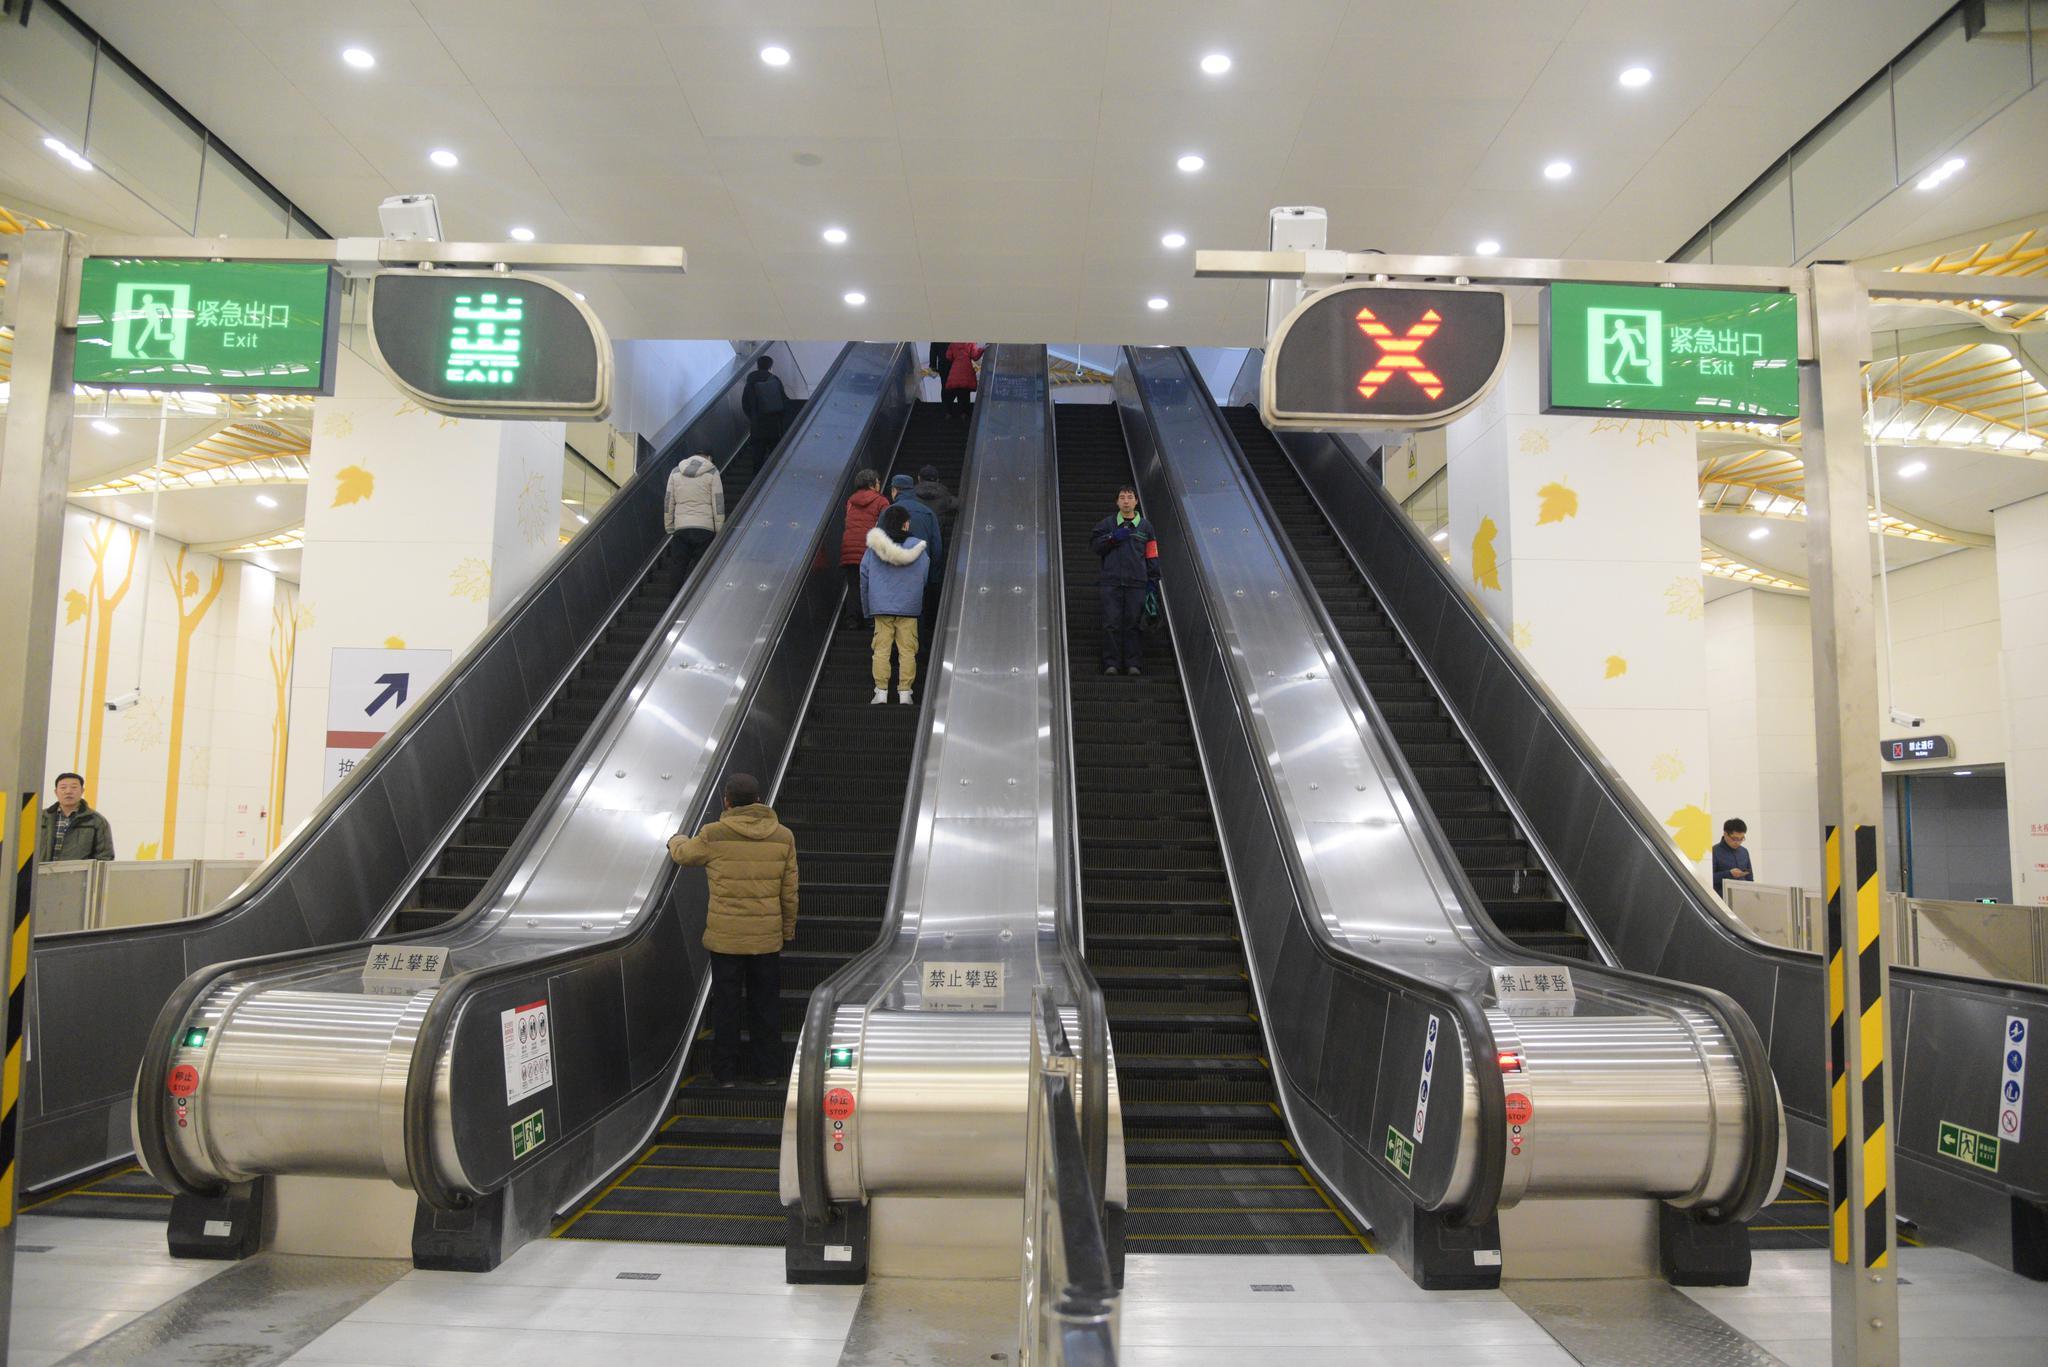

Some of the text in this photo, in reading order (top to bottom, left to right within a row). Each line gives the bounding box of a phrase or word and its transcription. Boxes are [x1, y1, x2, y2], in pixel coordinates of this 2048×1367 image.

[196, 299, 290, 329] 紧急出口
[223, 331, 259, 348] Exit
[1670, 326, 1763, 357] 紧急出口
[1699, 358, 1735, 376] Exit
[371, 951, 440, 972] 禁止攀登
[929, 969, 998, 988] 禁止攀登
[1499, 973, 1568, 992] 禁止攀登
[1508, 1113, 1526, 1121] STOP
